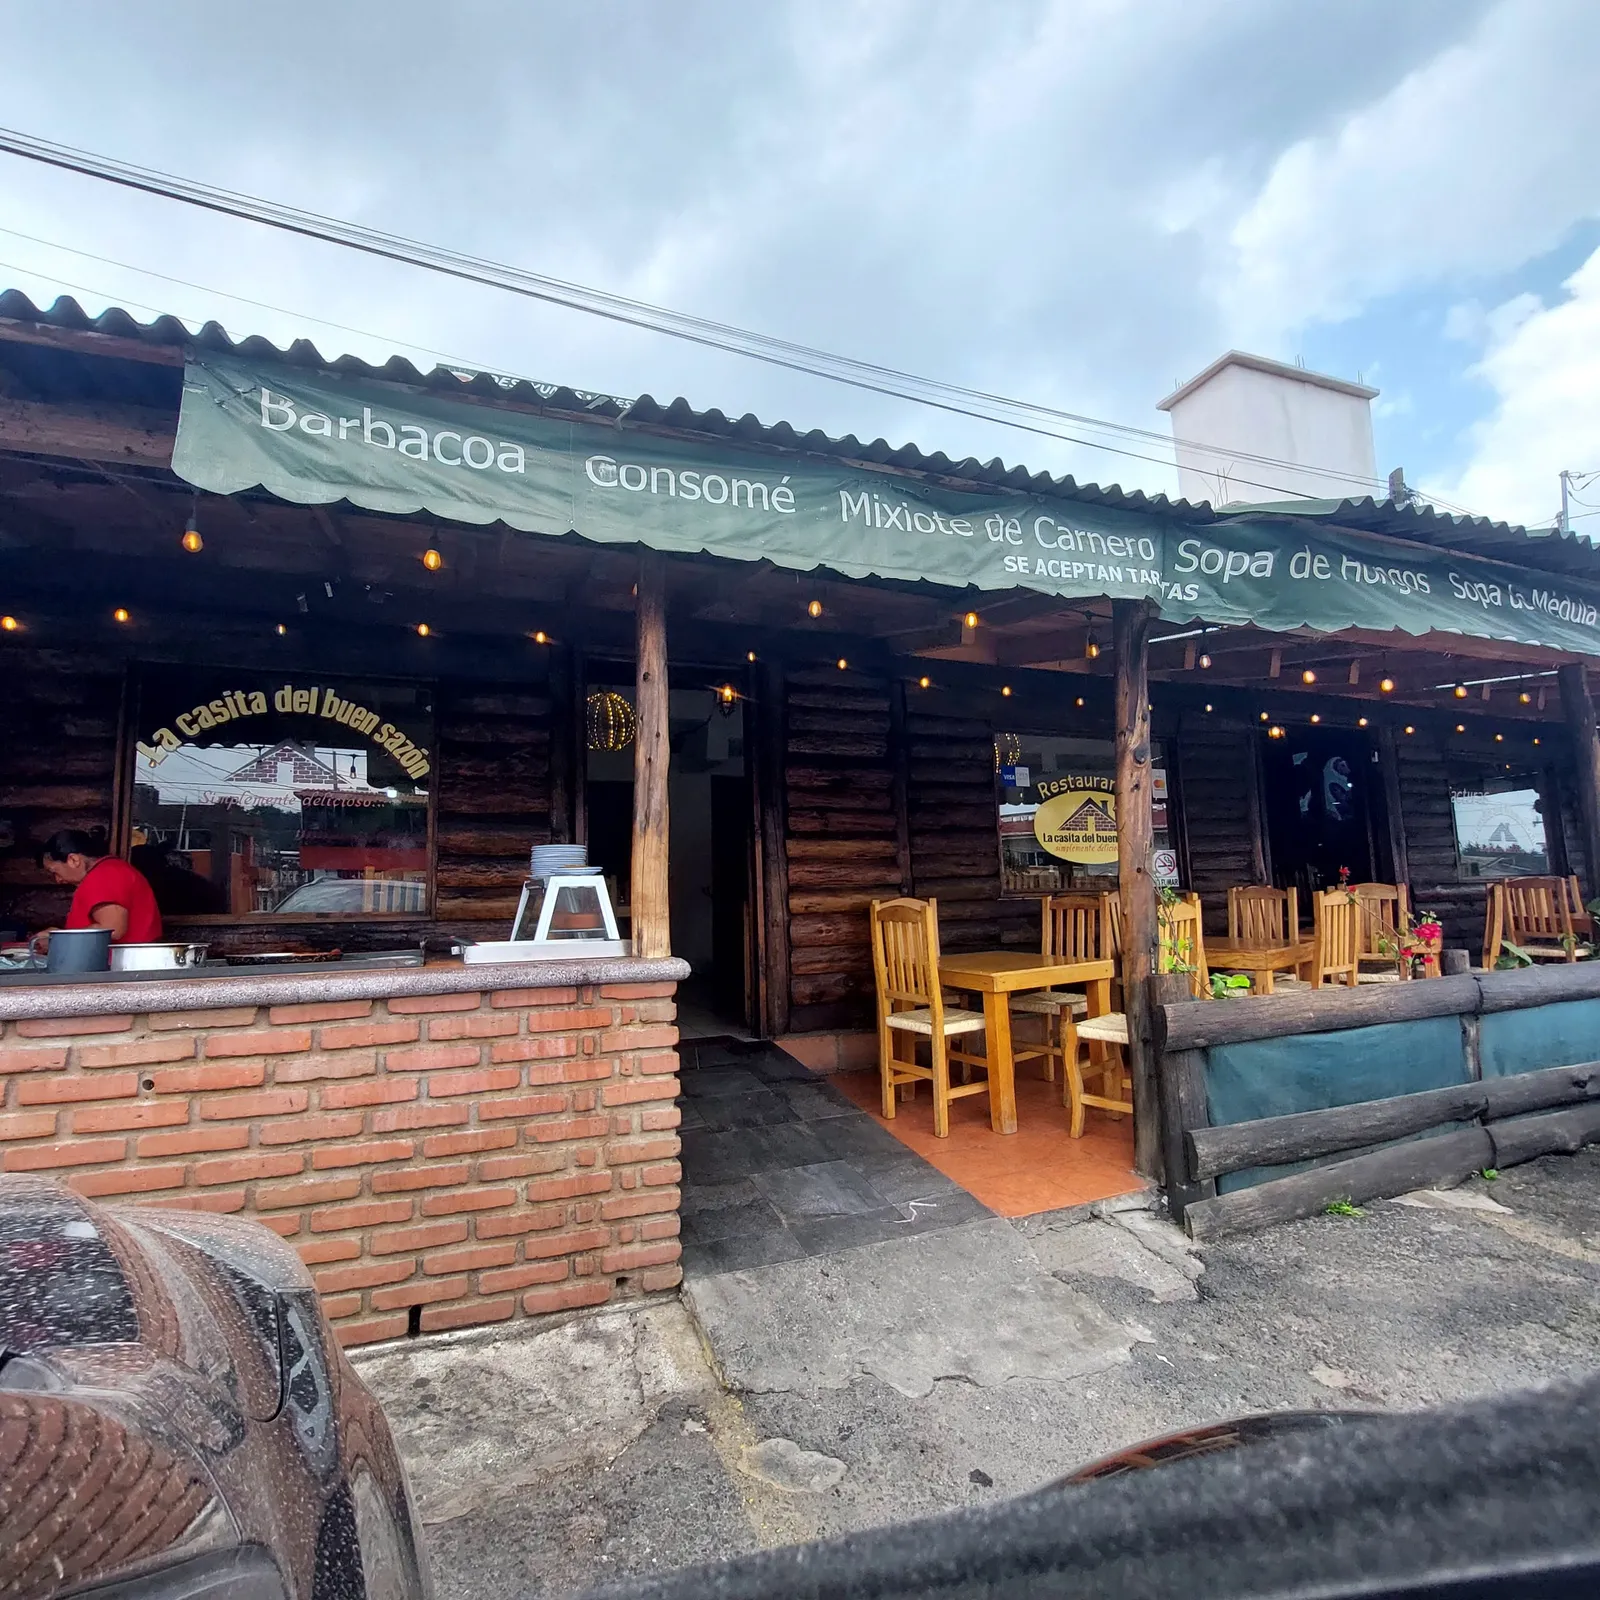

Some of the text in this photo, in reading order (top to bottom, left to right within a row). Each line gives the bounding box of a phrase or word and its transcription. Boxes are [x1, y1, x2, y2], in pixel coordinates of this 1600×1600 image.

[260, 386, 526, 474] Barbacoa
[584, 454, 797, 514] Consomé
[838, 490, 1155, 562] Mixiote de Carnero
[1003, 556, 1032, 574] SE
[1034, 557, 1123, 584] ACEPTAN
[1174, 539, 1275, 584] Sopa
[1289, 544, 1331, 580] de
[1448, 572, 1502, 609] Sopa
[135, 685, 431, 781] La casita del buen sazón
[200, 790, 296, 811] Simplemente
[1043, 833, 1118, 843] La casita del buen
